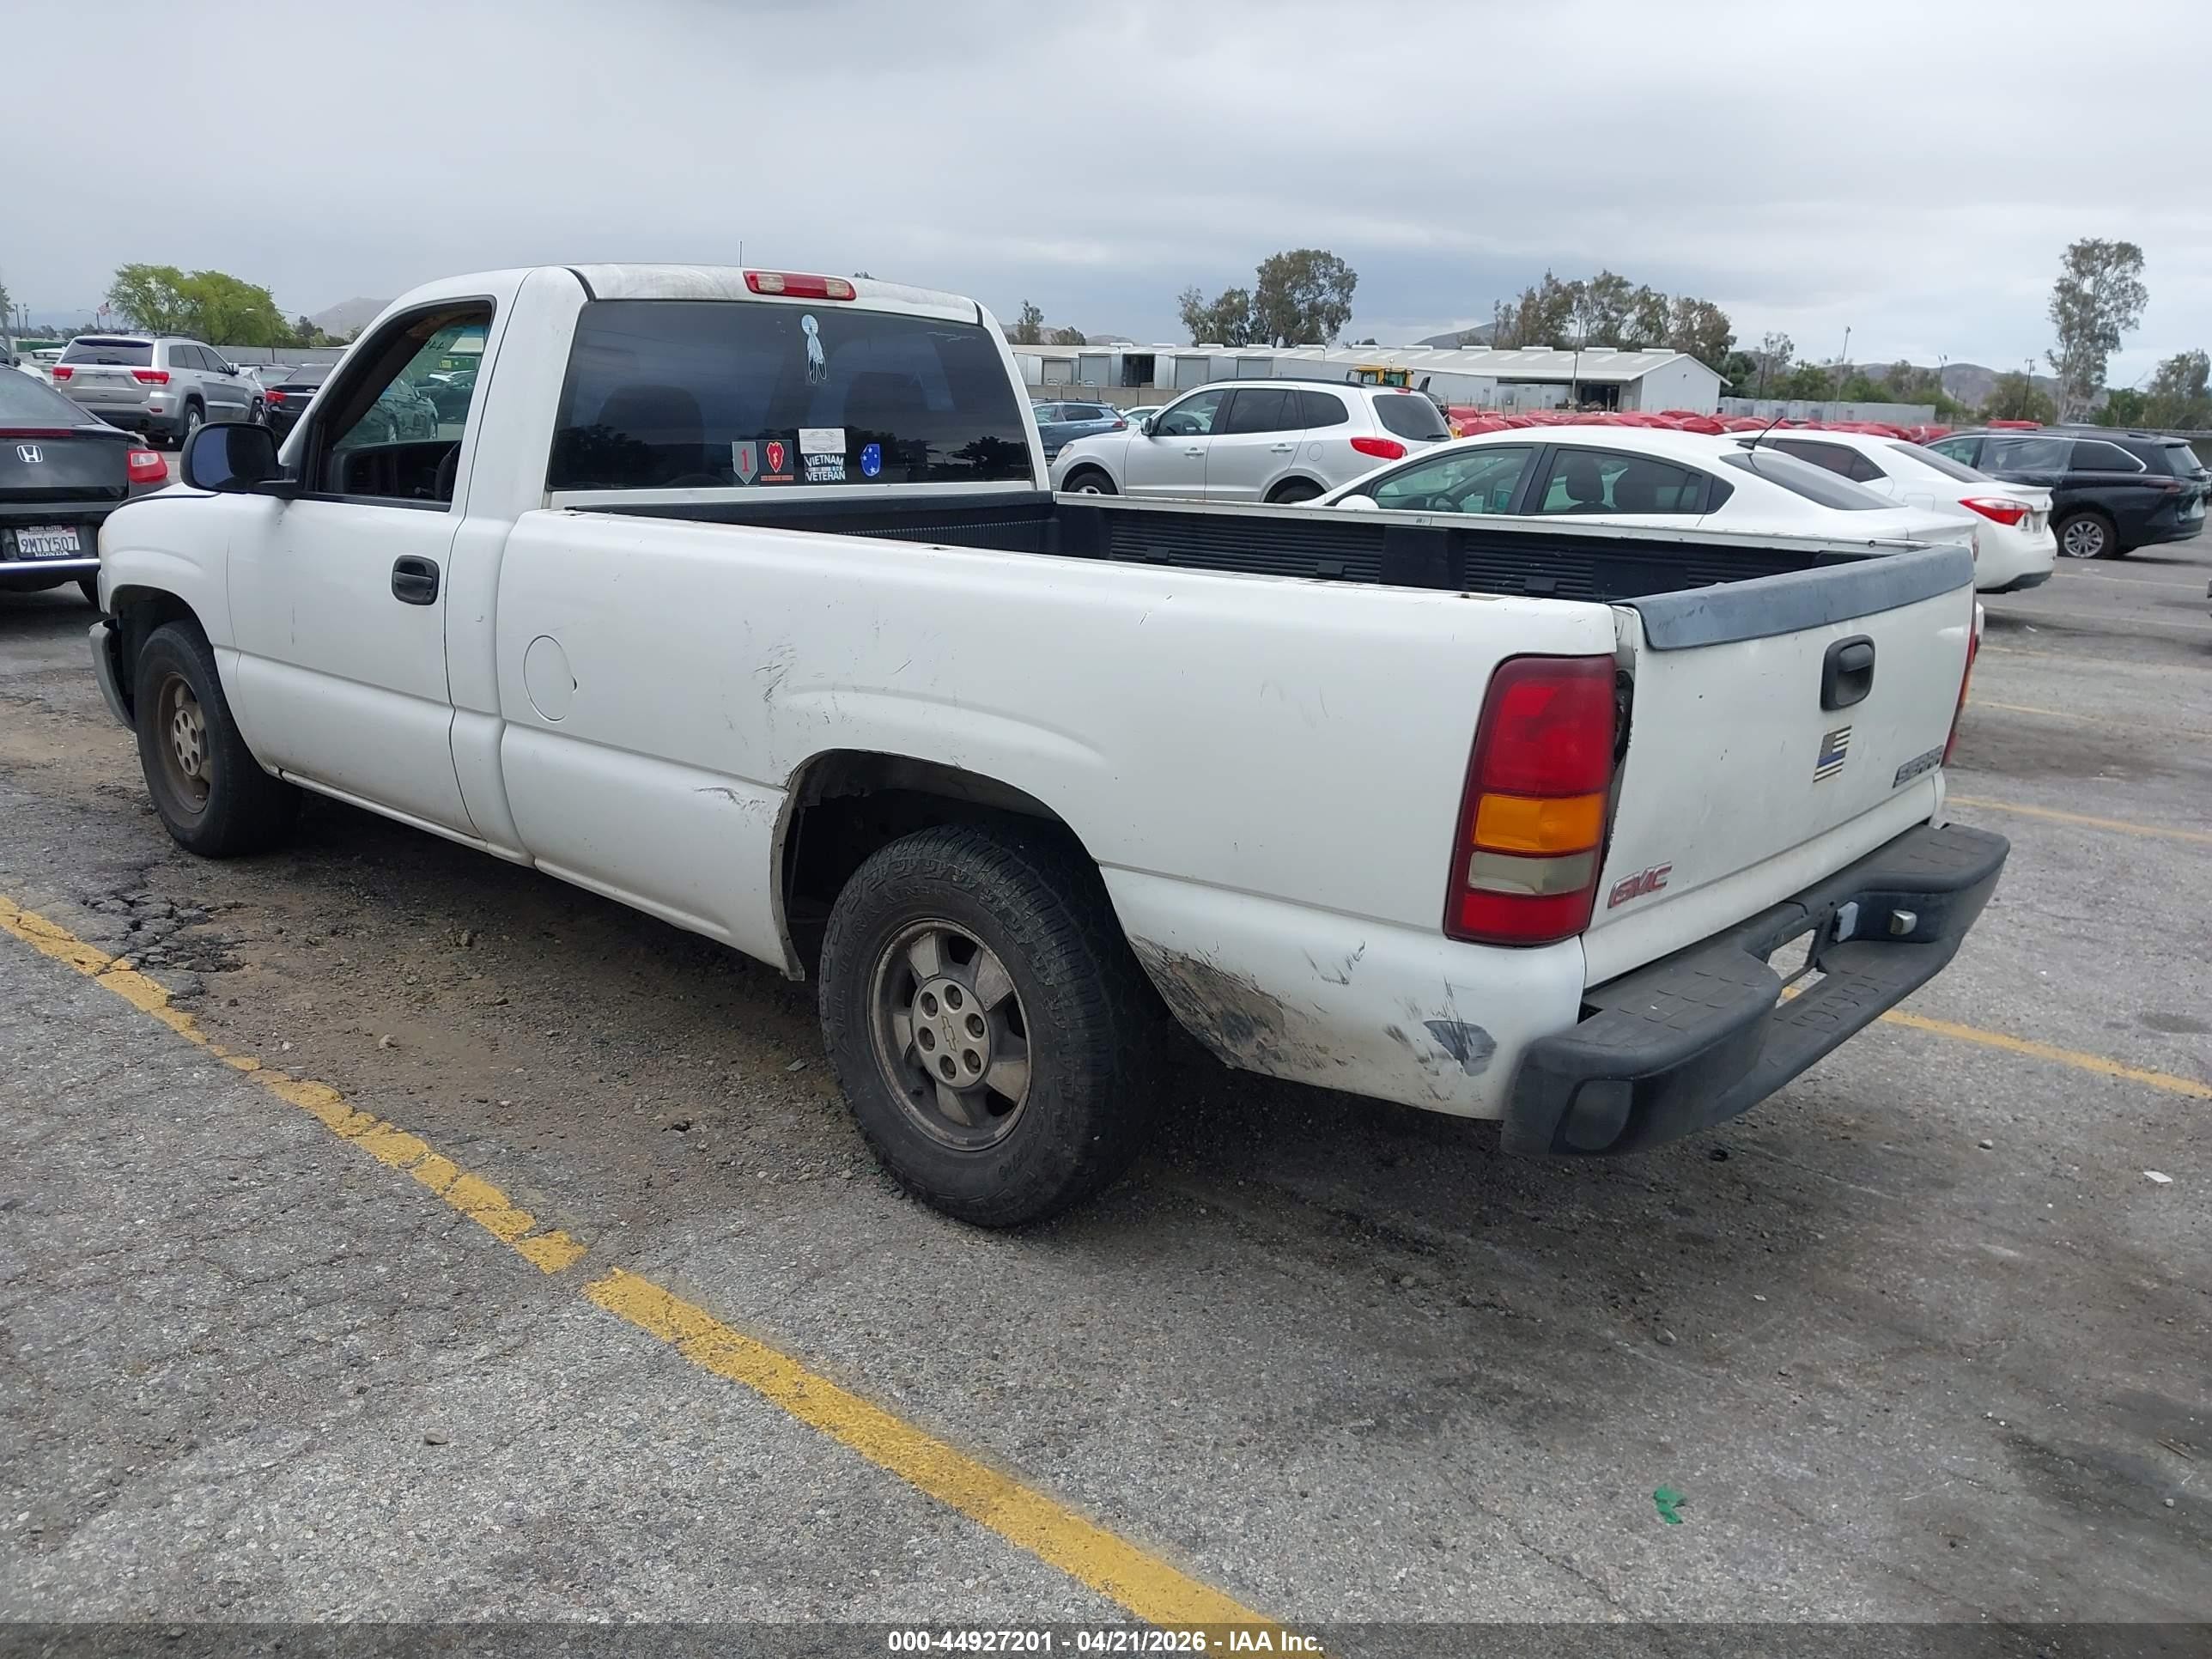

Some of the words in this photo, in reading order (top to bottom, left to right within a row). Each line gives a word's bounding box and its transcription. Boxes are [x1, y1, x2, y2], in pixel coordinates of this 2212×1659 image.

[741, 448, 750, 472] 1
[805, 454, 844, 467] VIETNAM
[805, 470, 845, 482] VETERAN
[21, 536, 76, 553] 9MTY507
[1607, 861, 1672, 909] GMC
